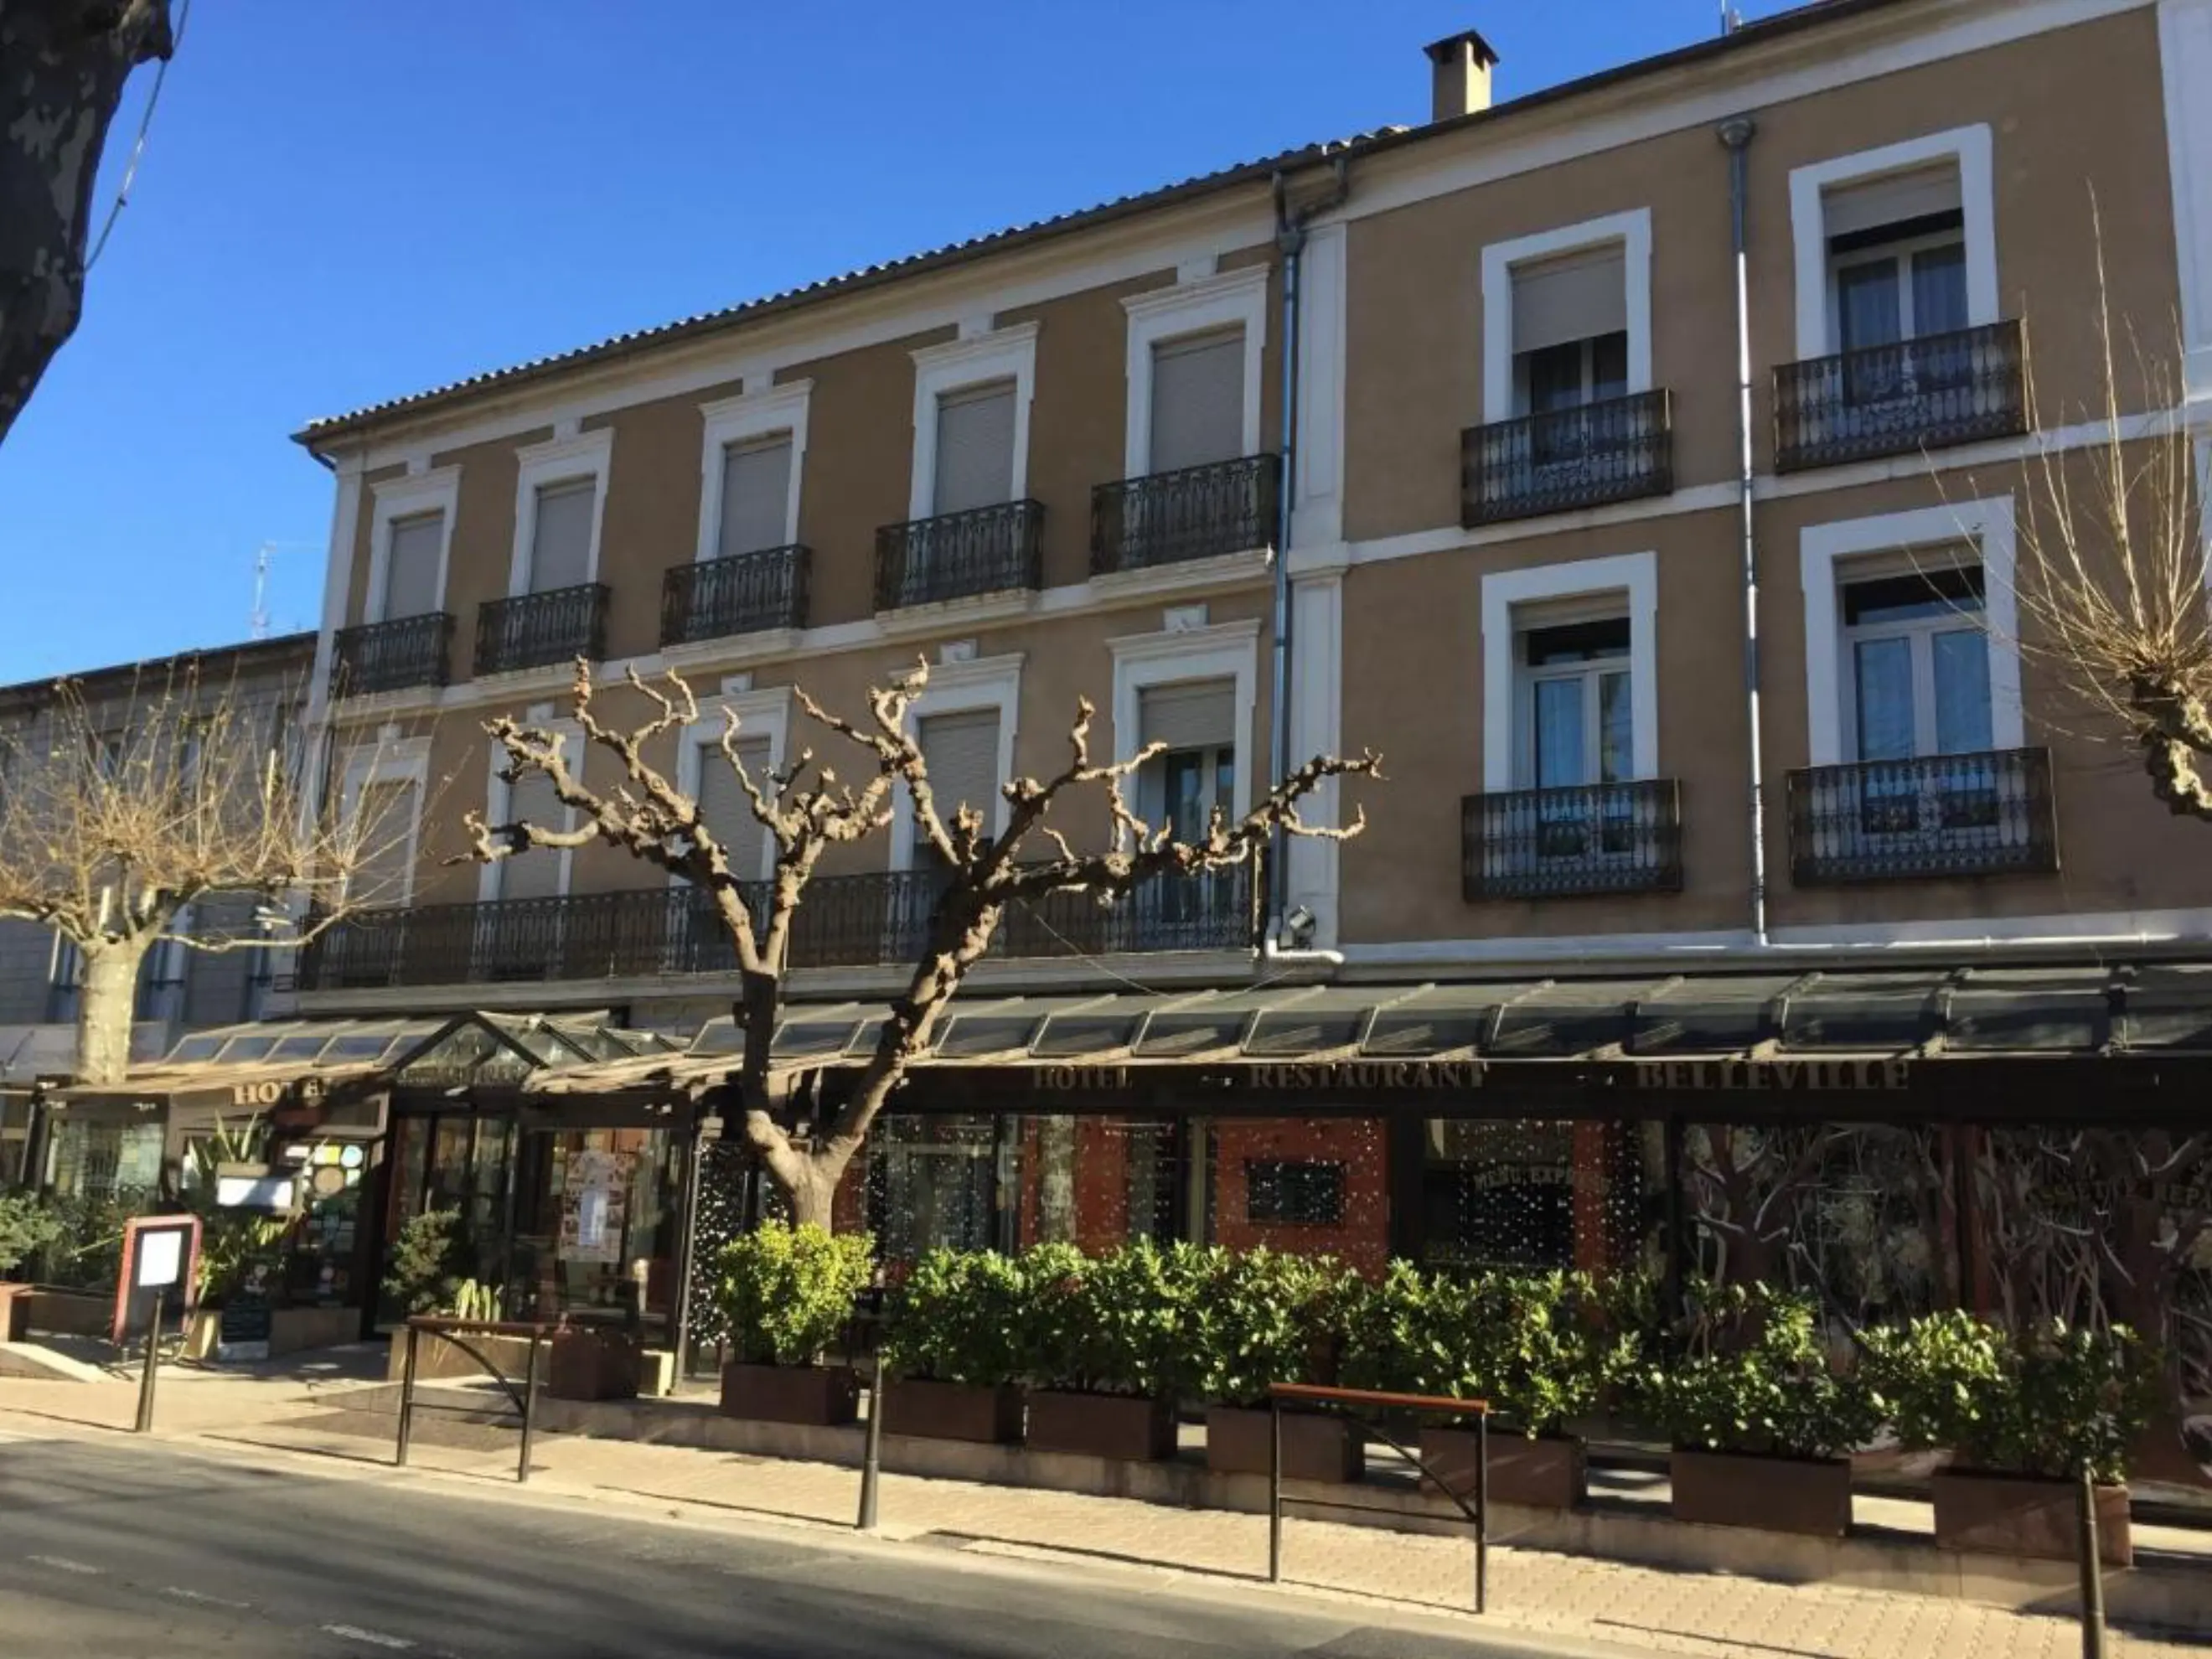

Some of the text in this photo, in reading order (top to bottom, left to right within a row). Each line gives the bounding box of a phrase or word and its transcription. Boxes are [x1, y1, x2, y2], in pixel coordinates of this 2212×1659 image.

[1033, 1065, 1133, 1090] HOTEL
[1249, 1063, 1486, 1089] RESTAURANT
[1636, 1061, 1910, 1090] BELLEVILLE
[234, 1078, 331, 1104] HOTEL
